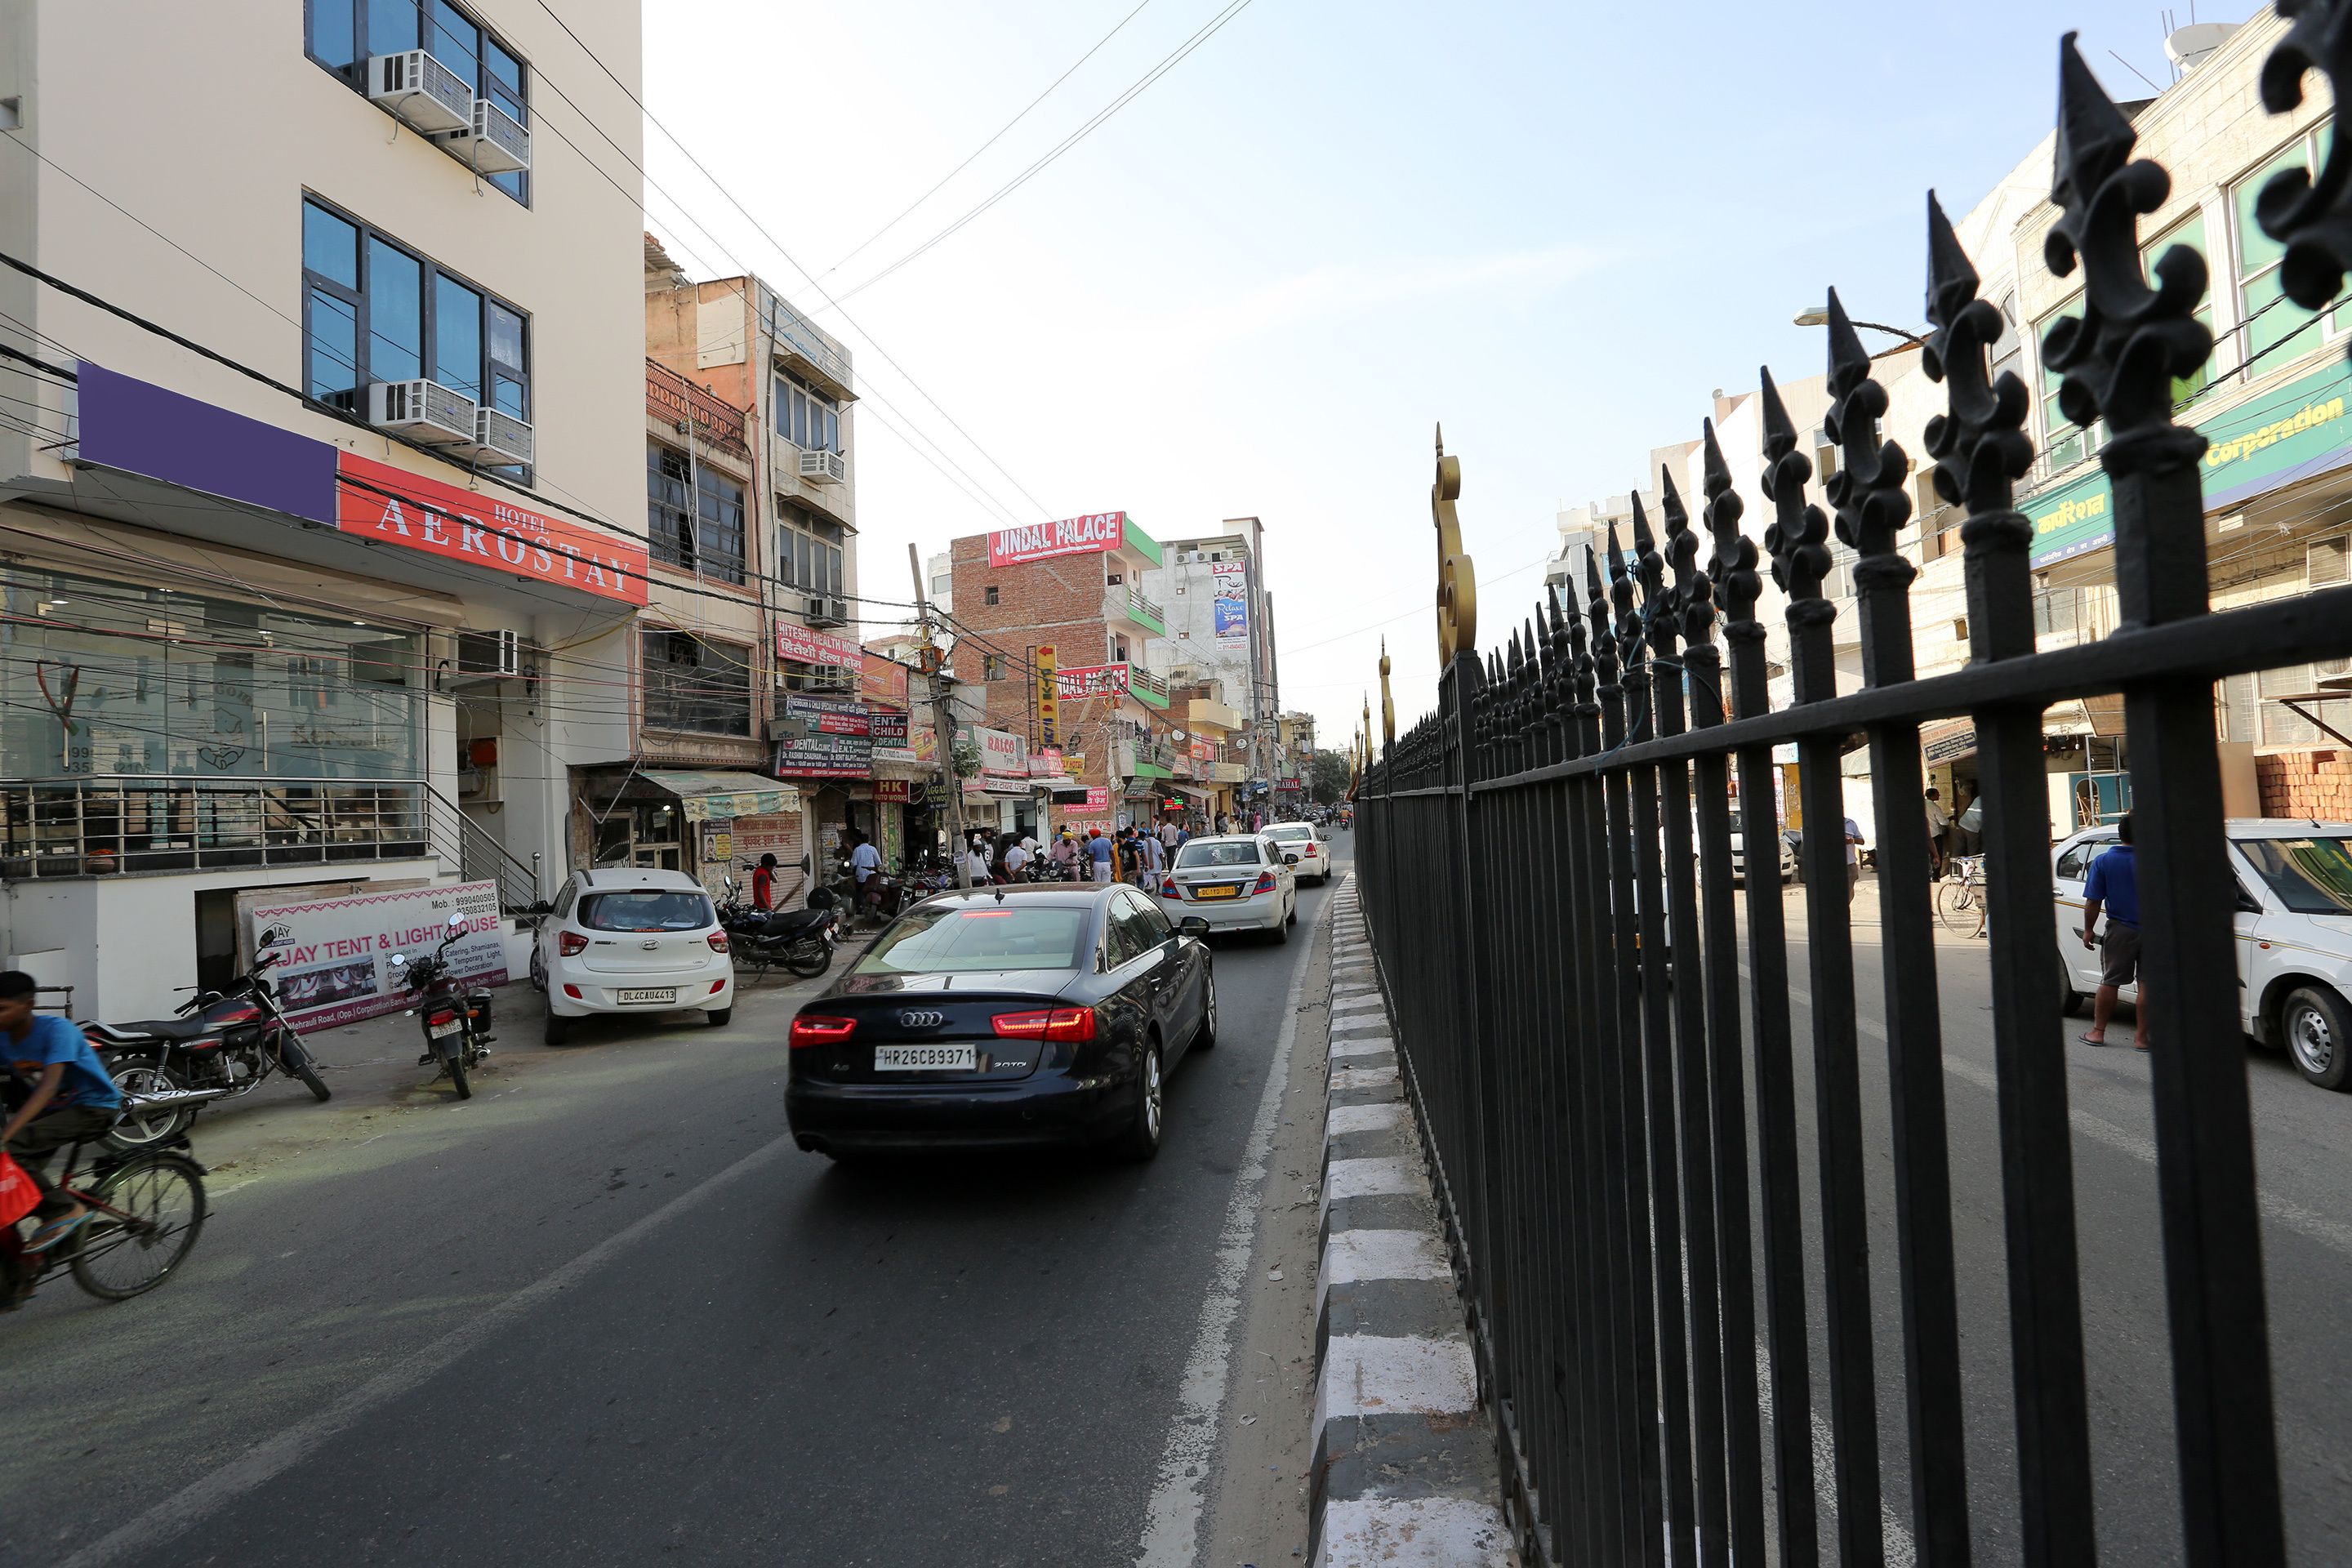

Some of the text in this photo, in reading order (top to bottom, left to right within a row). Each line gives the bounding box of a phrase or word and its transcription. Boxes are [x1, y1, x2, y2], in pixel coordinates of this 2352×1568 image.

[493, 504, 550, 534] HOTEL
[996, 514, 1116, 556] JINDAL PALACE
[376, 498, 630, 593] AEROSTAY
[1214, 562, 1243, 572] SPA
[779, 622, 862, 657] HITESHI HEALTH HOME
[874, 716, 896, 727] ENT
[874, 727, 904, 736] CHILD
[795, 738, 817, 751] DENTAL
[817, 743, 831, 751] CLINIC
[879, 737, 906, 747] DENTAL
[987, 736, 1014, 755] RALCO
[1004, 755, 1014, 766] Tyres
[432, 900, 450, 910] Mob.
[456, 893, 496, 906] 9990400505
[457, 903, 497, 915] 9350832105
[273, 927, 290, 938] JAY
[265, 915, 498, 969] AJAY TENT & LIGHT HOUSE
[445, 947, 470, 957] Catering,
[455, 954, 483, 964] Temporary
[465, 961, 493, 972] Decoration
[478, 977, 489, 985] Delhi
[492, 972, 506, 982] 110037
[624, 991, 675, 1000] DL4CAU4413
[289, 1017, 317, 1030] Mehrauli
[318, 1014, 336, 1024] Road,
[337, 1009, 356, 1021] (Opp.)
[356, 1001, 390, 1015] Corporation
[391, 997, 406, 1006] Bank,
[884, 1046, 973, 1066] HR26CB9371
